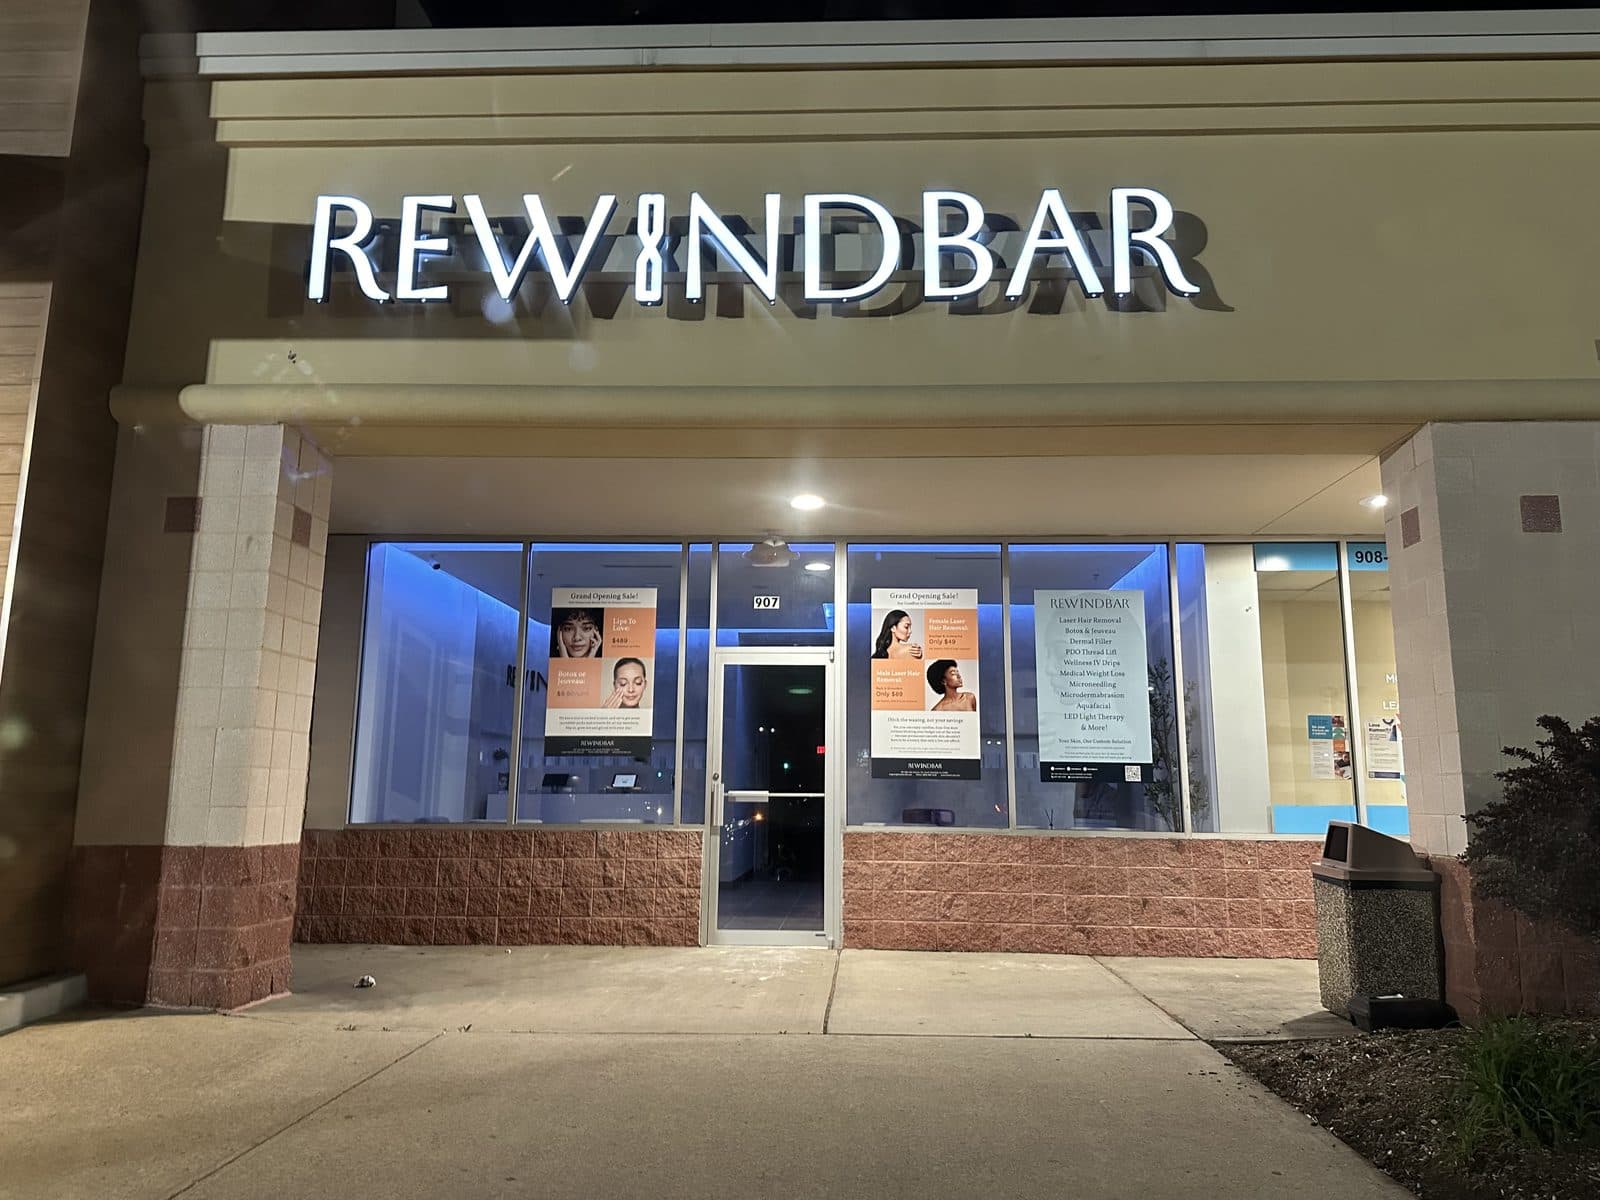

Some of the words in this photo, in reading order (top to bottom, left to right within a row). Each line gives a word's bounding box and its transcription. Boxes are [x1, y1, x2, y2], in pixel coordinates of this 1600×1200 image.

[307, 188, 1201, 304] REWINDBAR
[593, 592, 621, 600] Opening
[912, 592, 941, 600] Opening
[755, 597, 779, 608] 907
[1050, 598, 1130, 609] REWINDBAR
[613, 618, 627, 626] Lips
[1093, 616, 1122, 624] Removal
[1102, 660, 1120, 668] Drips
[1086, 670, 1109, 678] Weight
[1385, 673, 1398, 684] M
[1382, 700, 1399, 711] LE
[1079, 713, 1097, 721] Light
[1097, 713, 1124, 721] Therapy
